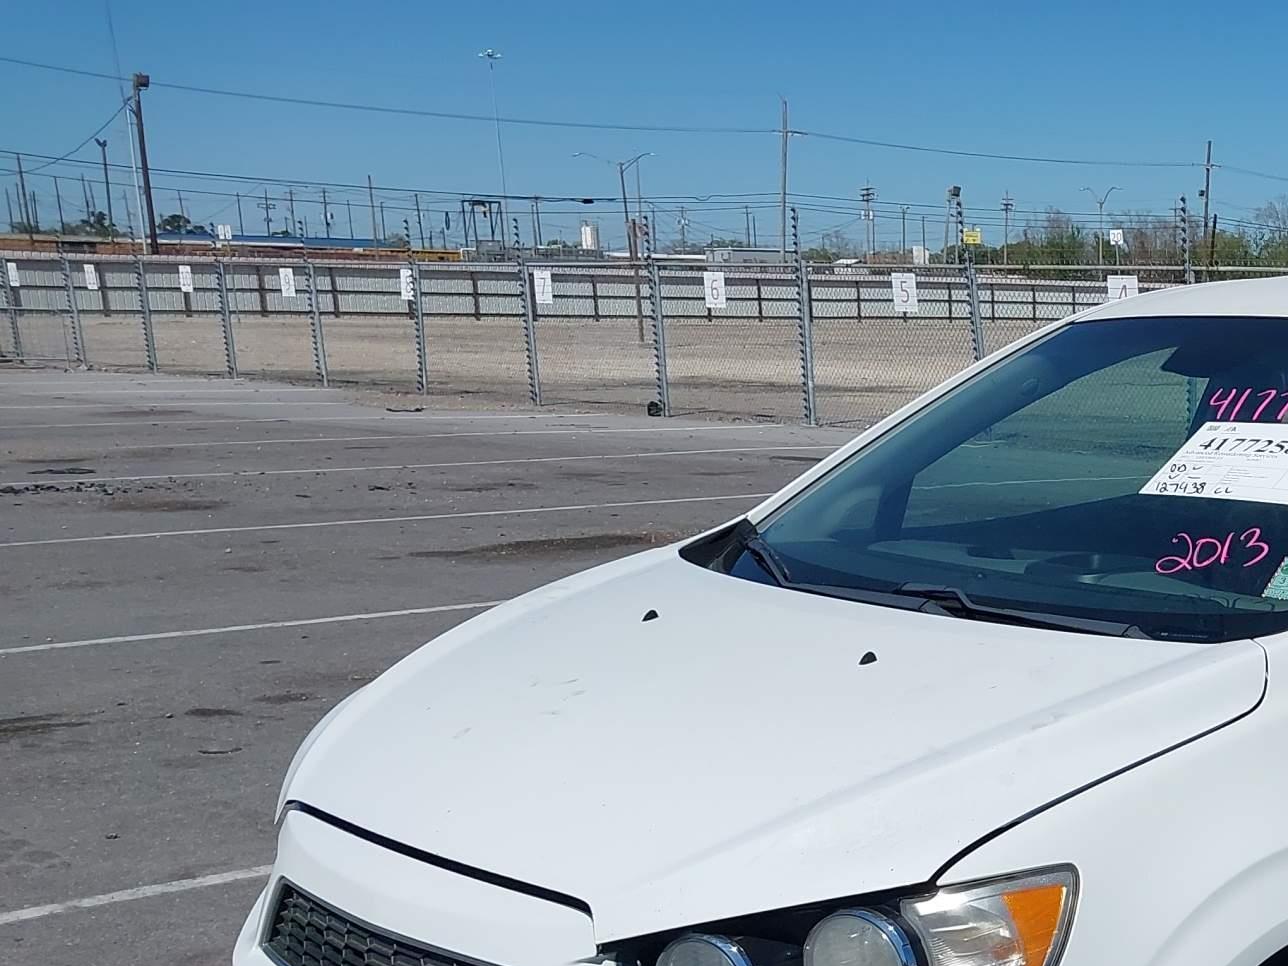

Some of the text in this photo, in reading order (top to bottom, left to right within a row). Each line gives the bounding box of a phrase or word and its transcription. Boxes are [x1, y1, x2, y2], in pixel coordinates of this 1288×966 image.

[536, 277, 546, 297] 7
[710, 279, 720, 300] 6
[900, 280, 910, 303] 5
[1155, 527, 1270, 574] 2013
